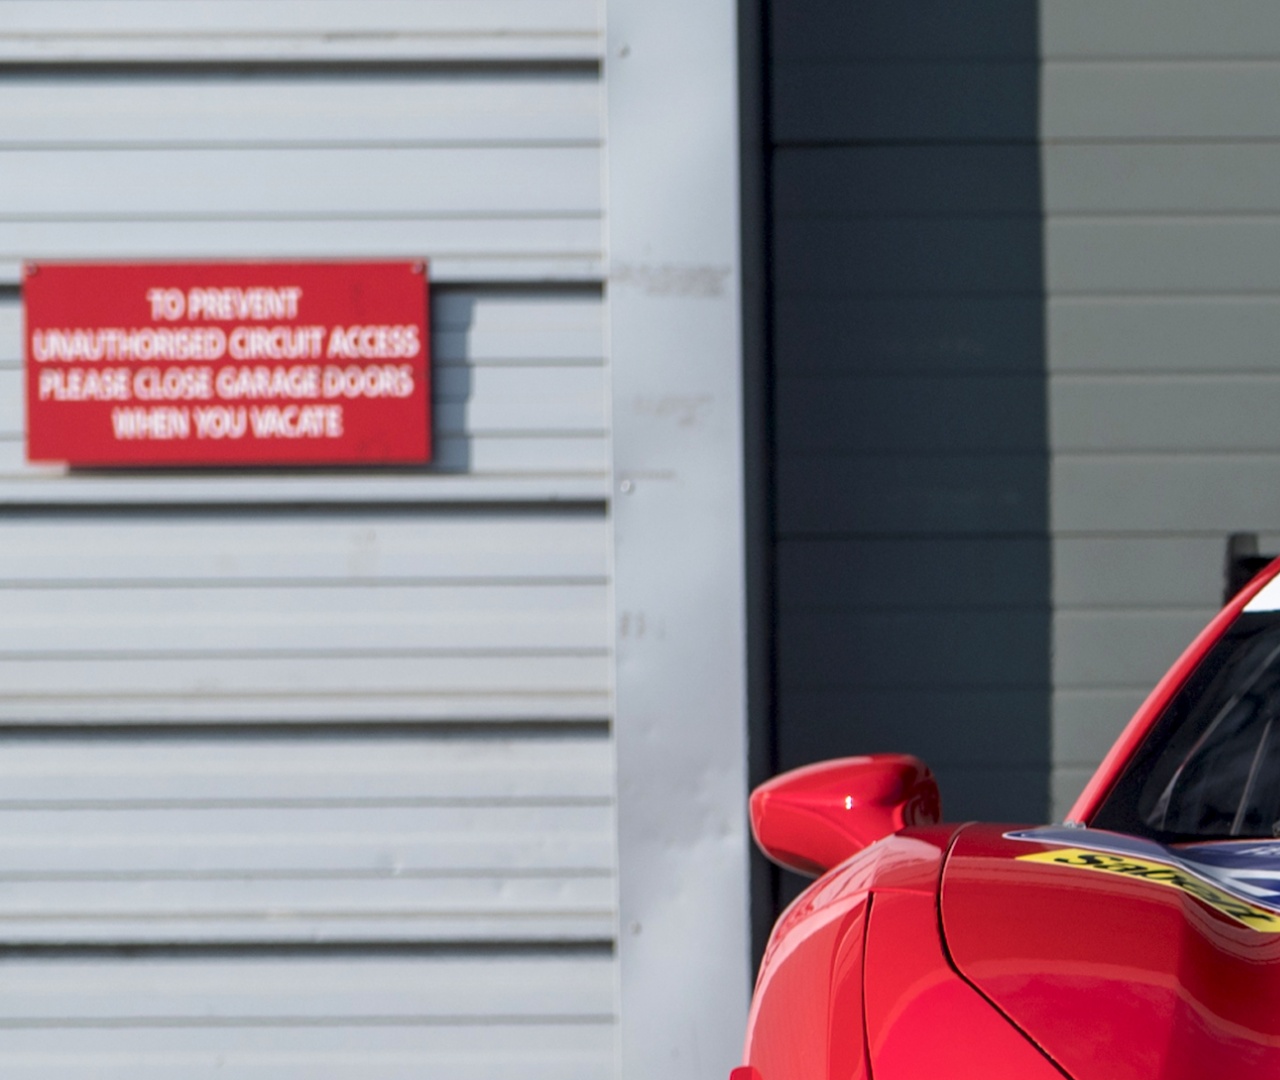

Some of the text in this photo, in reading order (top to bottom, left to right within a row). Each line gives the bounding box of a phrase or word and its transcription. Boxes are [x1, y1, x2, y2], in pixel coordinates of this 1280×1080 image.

[147, 287, 301, 321] TO PREVENT
[33, 325, 419, 361] UNAUTHORISED CIRCUIT ACCESS
[39, 365, 414, 400] PLEASE CLOSE GARAGE DOORS
[113, 405, 342, 439] WHEN YOU VACATE
